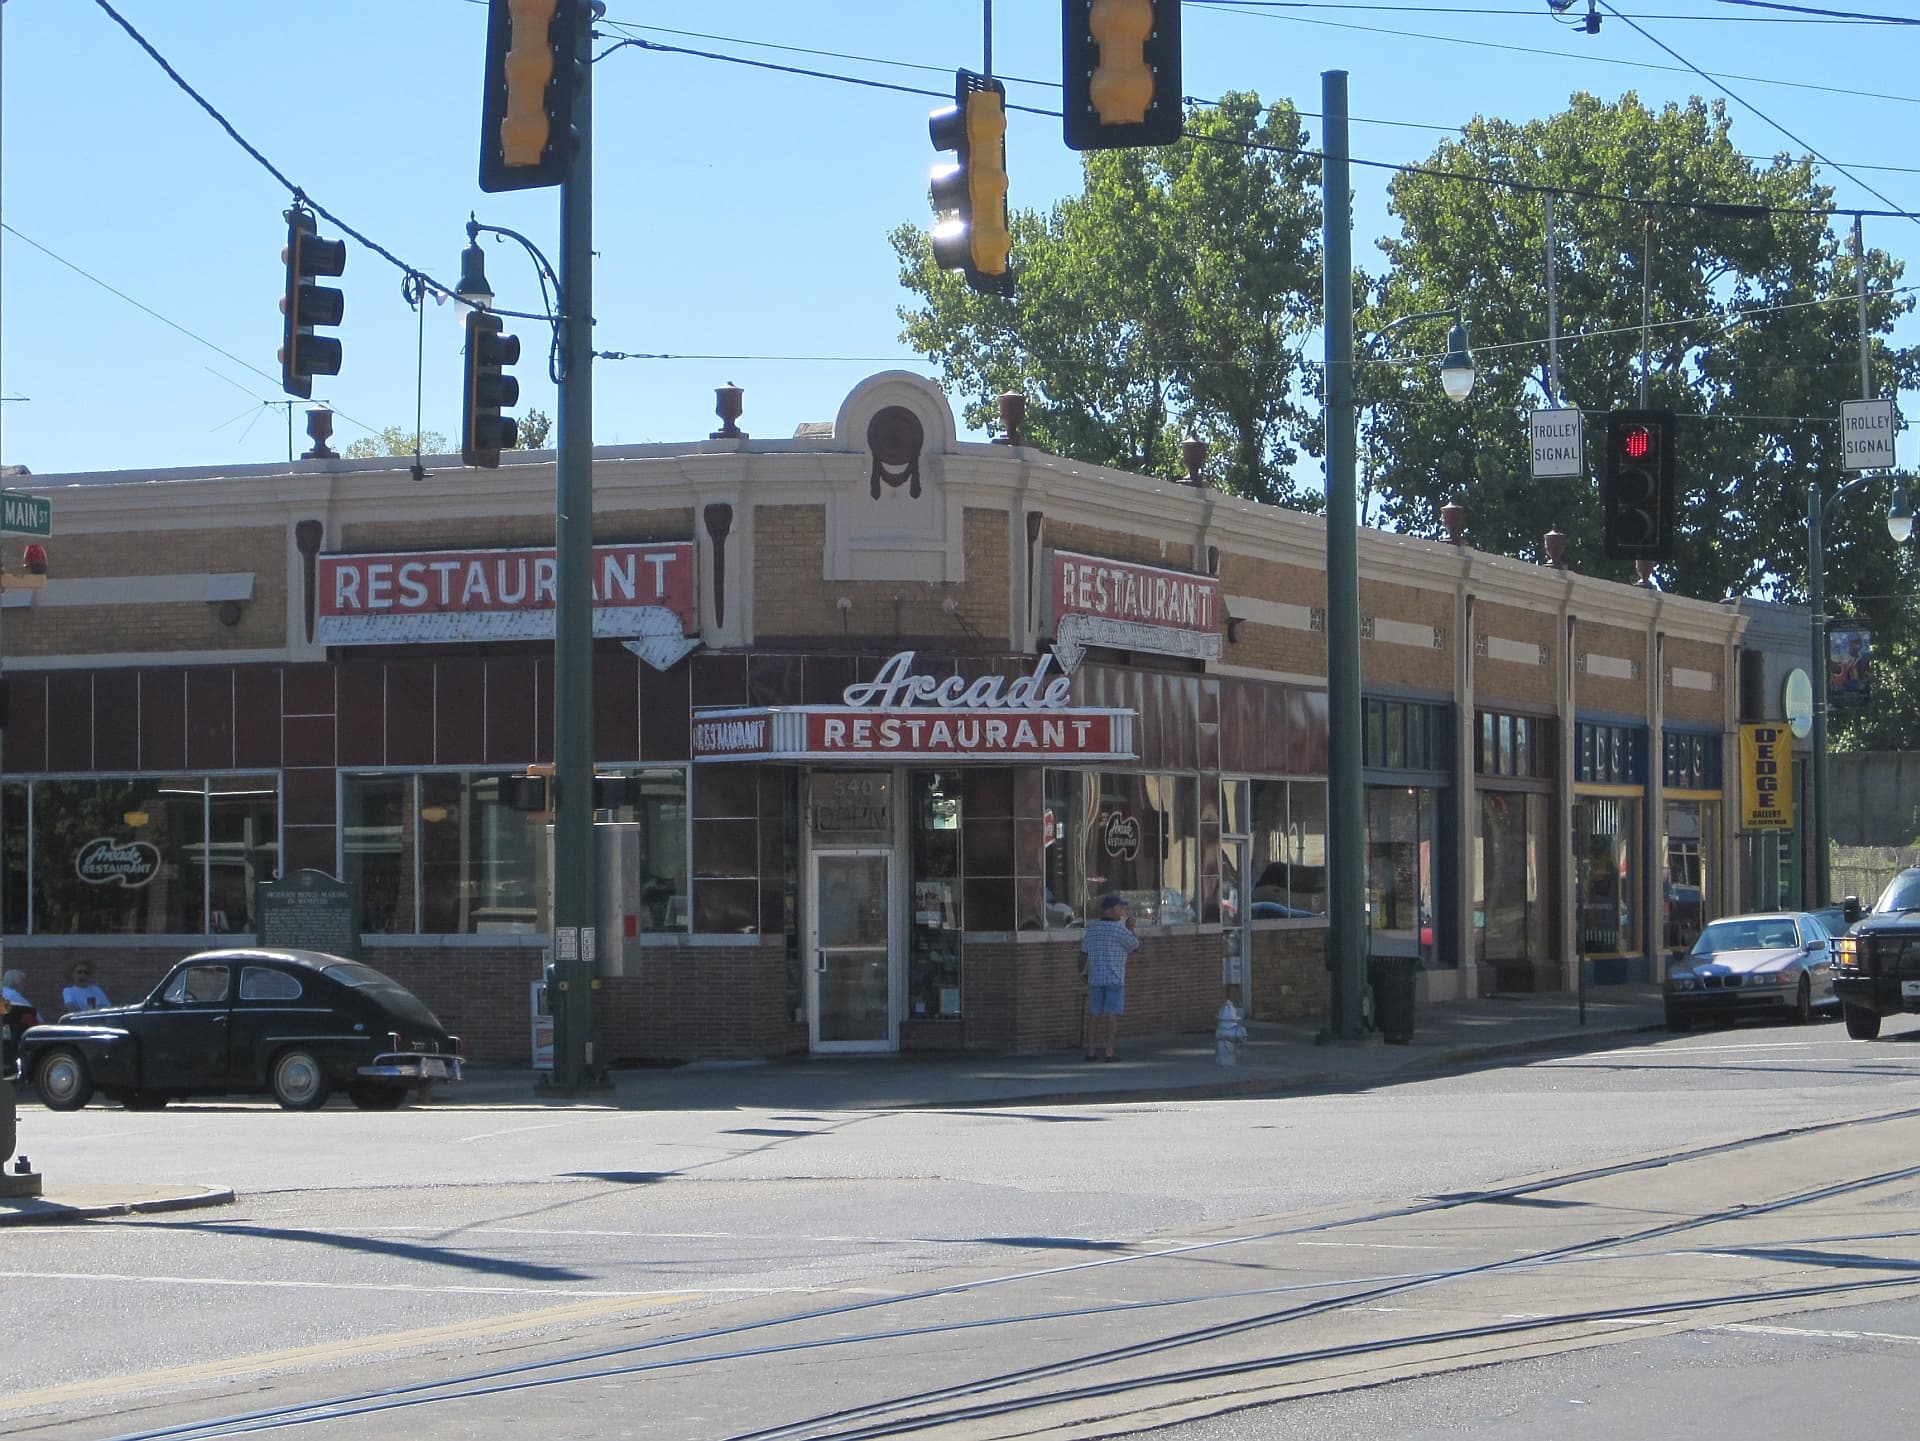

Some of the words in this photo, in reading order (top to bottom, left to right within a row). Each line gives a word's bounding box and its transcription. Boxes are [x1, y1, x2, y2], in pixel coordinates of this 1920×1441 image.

[1534, 424, 1577, 438] TROLLEY
[1844, 416, 1889, 431] TROLLEY
[1535, 447, 1578, 460] SIGNAL
[1847, 440, 1891, 453] SIGNAL
[5, 500, 38, 527] MAIN
[39, 510, 48, 523] ST
[335, 553, 676, 608] RESTAURNT
[1063, 562, 1216, 627] RESTAURANT
[843, 651, 1070, 708] Arcade
[824, 719, 1092, 749] RESTAURANT
[833, 779, 872, 796] 540
[82, 864, 152, 873] RESTAURANT
